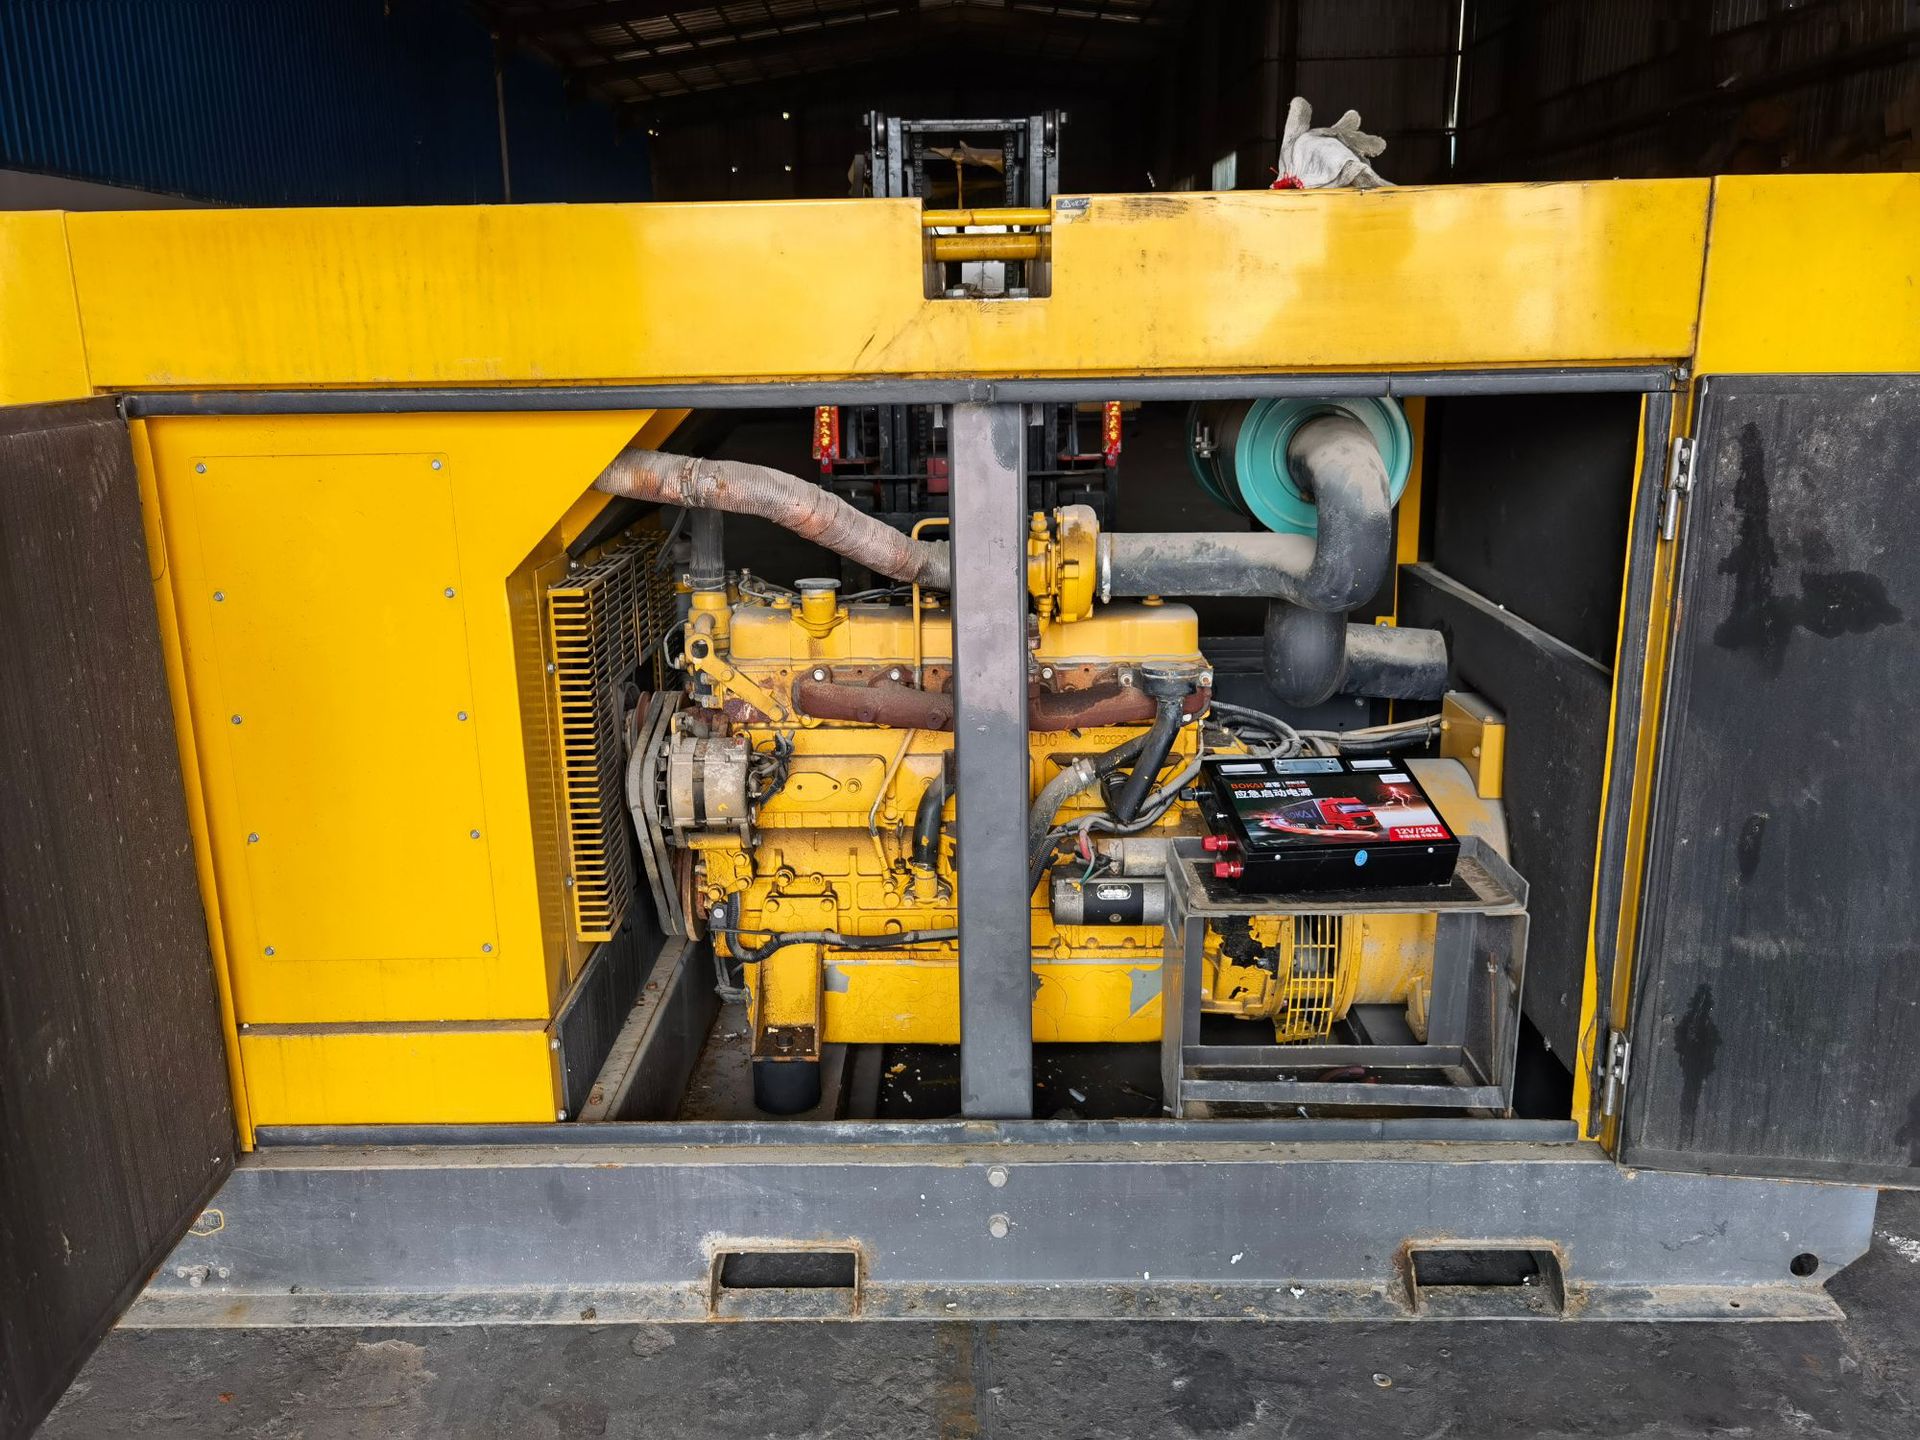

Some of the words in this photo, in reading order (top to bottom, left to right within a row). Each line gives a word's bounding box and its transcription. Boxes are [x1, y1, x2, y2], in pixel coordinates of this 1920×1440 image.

[1234, 787, 1313, 799] 应急启动电源
